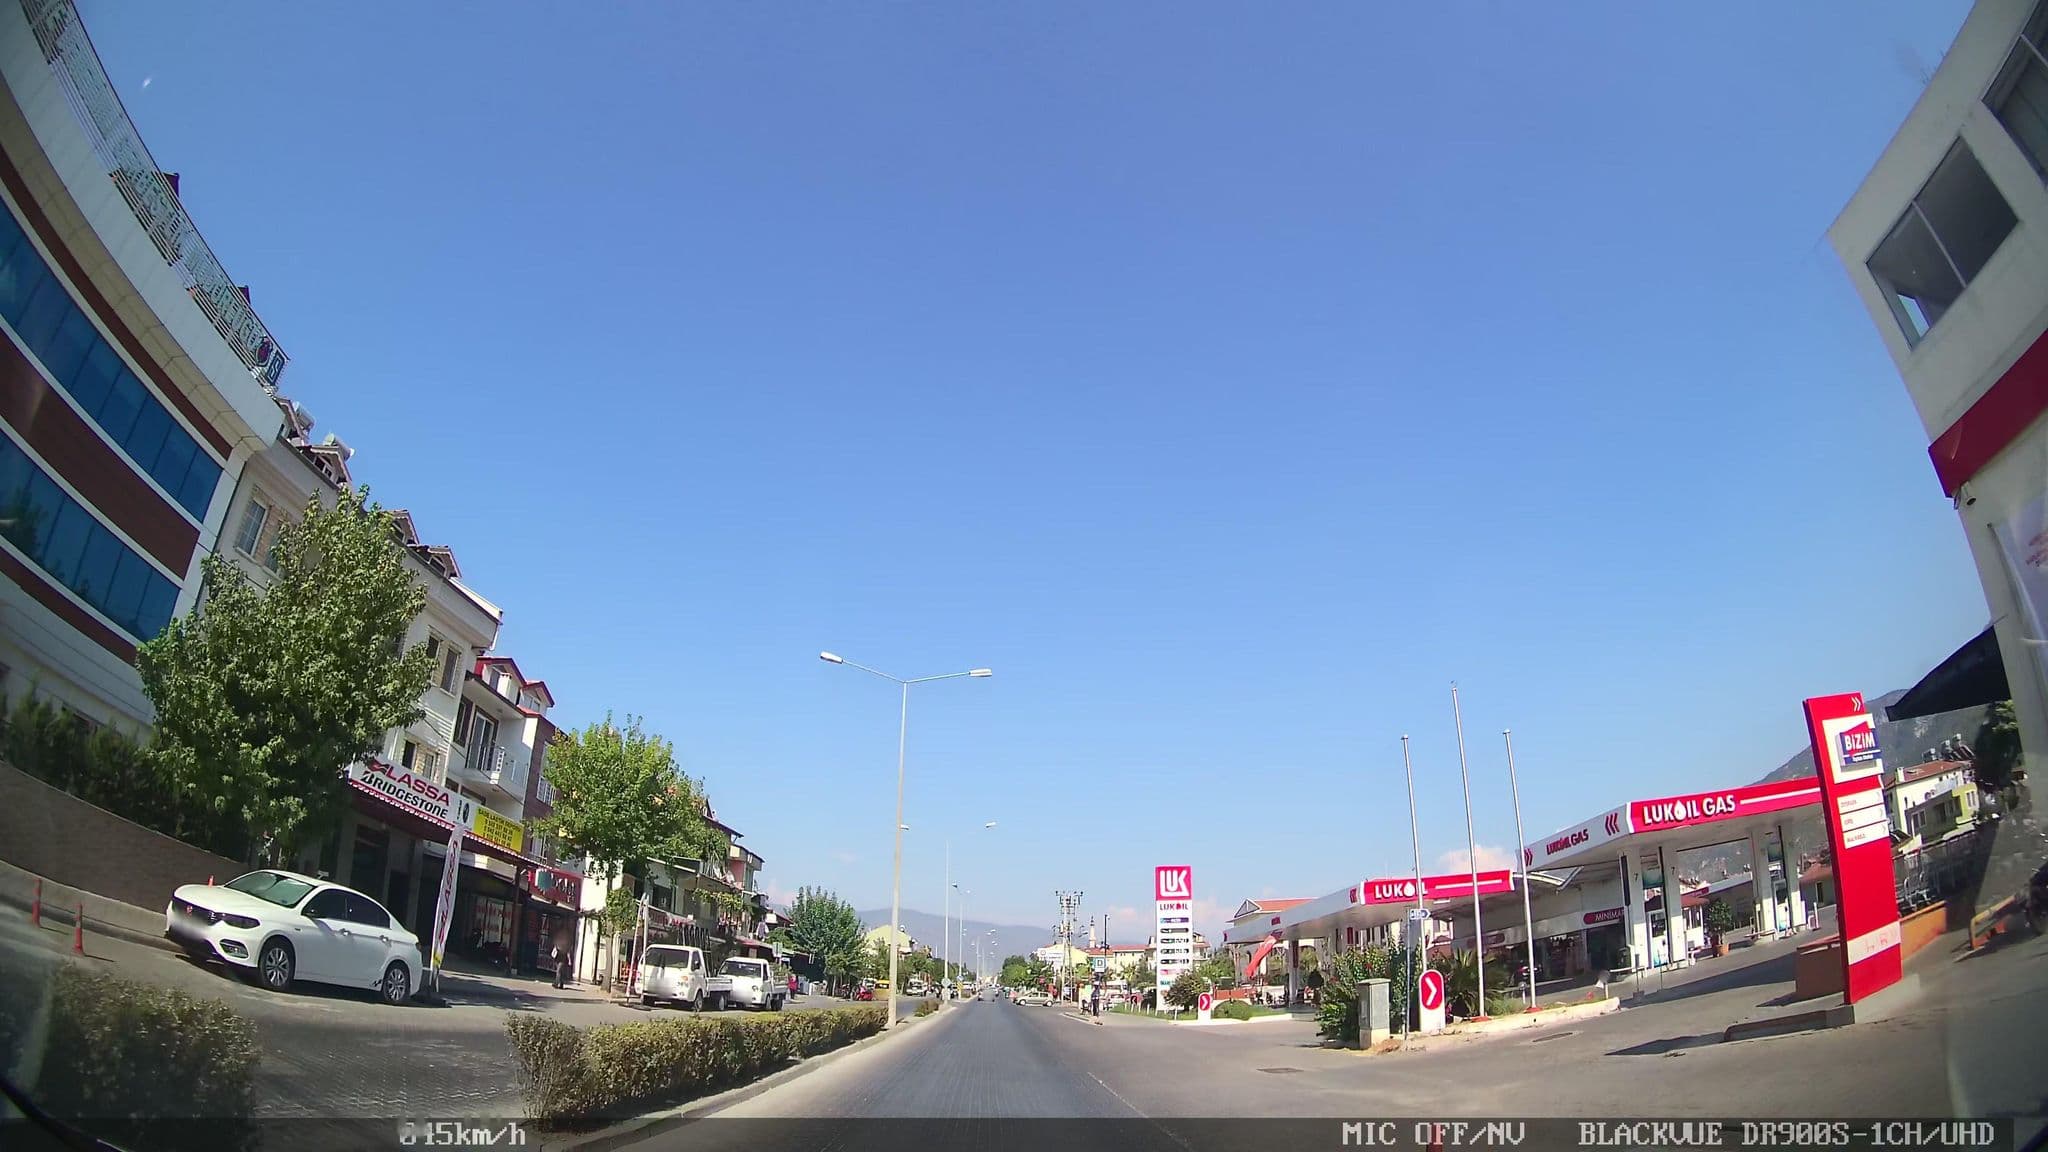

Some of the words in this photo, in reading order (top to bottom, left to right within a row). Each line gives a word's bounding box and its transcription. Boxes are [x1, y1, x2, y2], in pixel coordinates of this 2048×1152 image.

[361, 771, 449, 819] BRIDGESTONE
[386, 765, 450, 806] LASSA
[1643, 800, 1701, 825] LUKOIL
[1702, 794, 1736, 816] GAS
[1570, 828, 1589, 846] GAS
[1160, 870, 1190, 897] LUK
